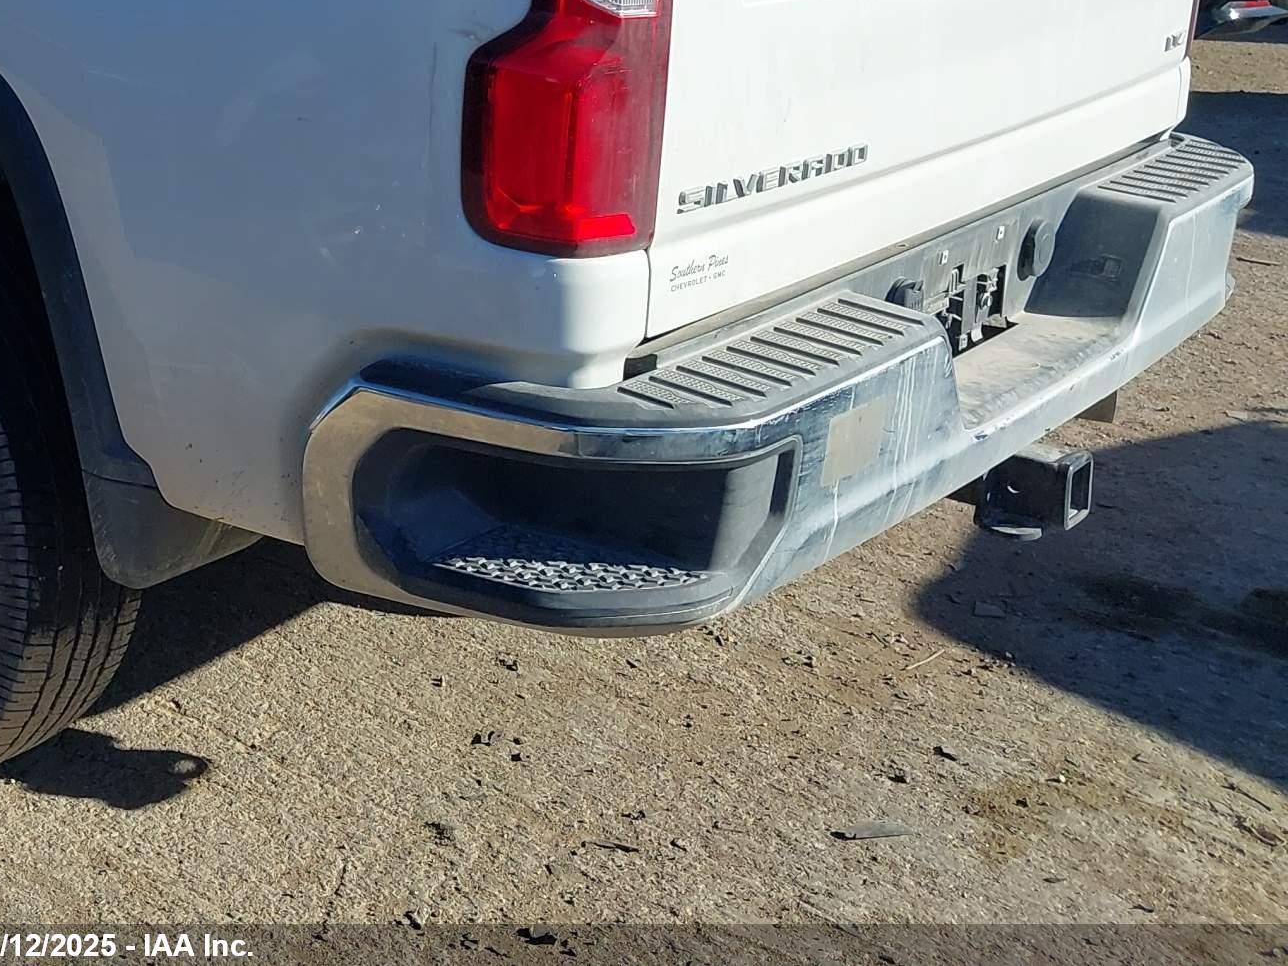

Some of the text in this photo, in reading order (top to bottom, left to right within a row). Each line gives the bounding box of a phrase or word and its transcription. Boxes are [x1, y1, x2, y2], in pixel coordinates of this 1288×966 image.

[676, 143, 868, 214] SILVERADO
[669, 259, 705, 282] Southern
[670, 269, 726, 292] CHEVROLET GMC
